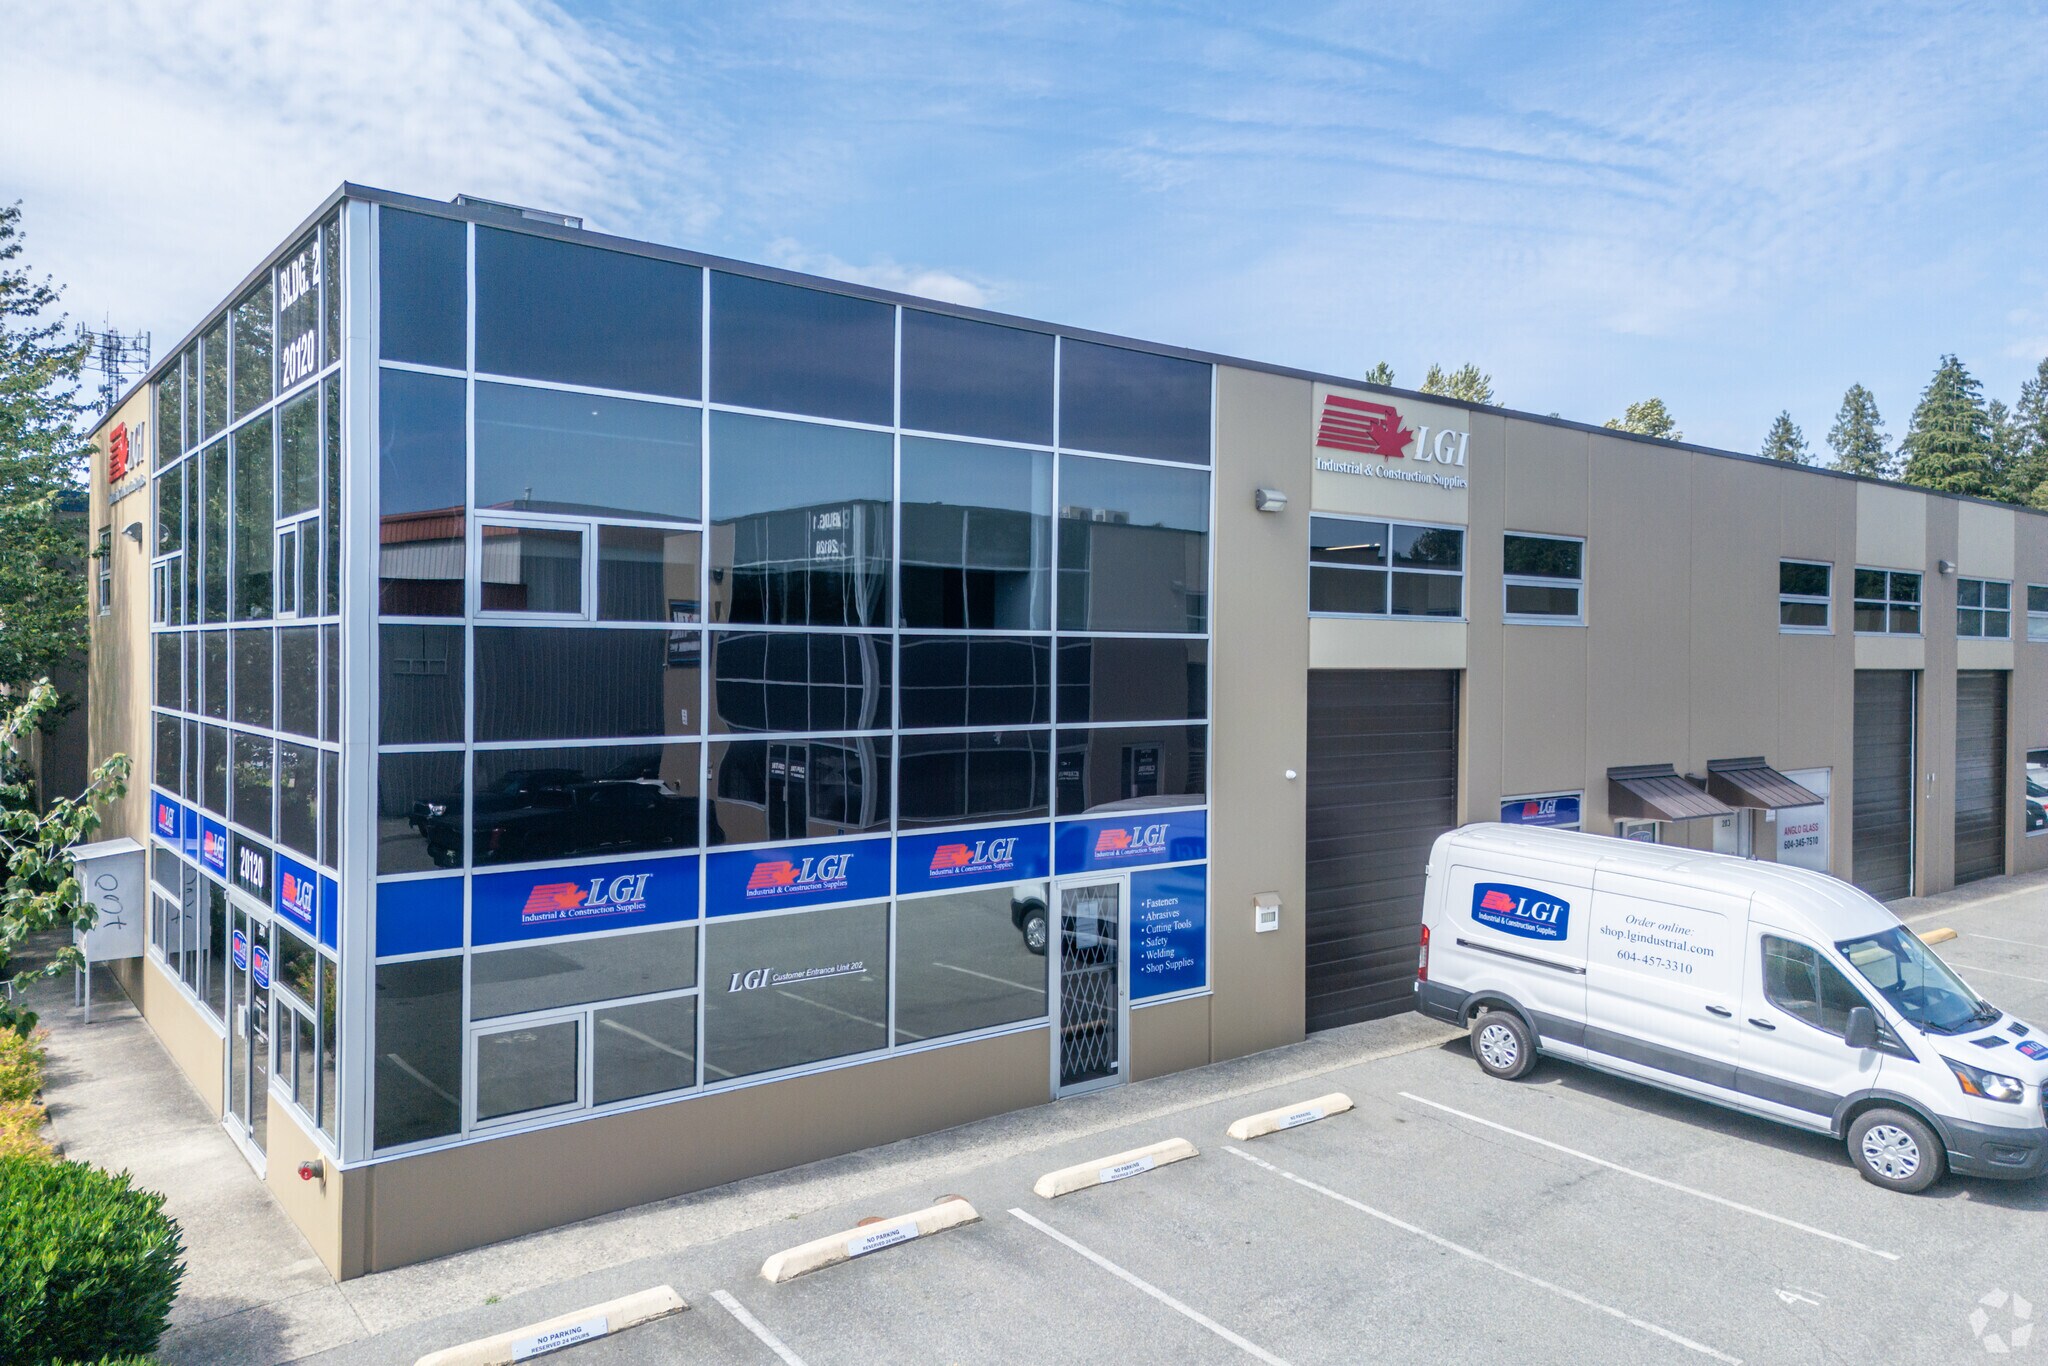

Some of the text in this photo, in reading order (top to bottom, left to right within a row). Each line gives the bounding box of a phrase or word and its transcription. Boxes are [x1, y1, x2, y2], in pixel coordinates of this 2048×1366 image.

[280, 242, 320, 312] BLDG. 2
[282, 330, 314, 388] 20120
[1414, 426, 1470, 468] LGI
[1316, 457, 1468, 490] Industrial & Construction Supplies
[1538, 800, 1558, 814] LGI
[1130, 824, 1168, 848] LGI
[1784, 823, 1818, 835] ANGLO GLASS
[972, 837, 1016, 864] LGI
[1121, 846, 1148, 855] Construction
[1784, 836, 1818, 850] 604-345-7510
[240, 846, 263, 888] 20120
[797, 854, 851, 883] LGI
[961, 864, 992, 872] Construction
[296, 878, 314, 911] LGI
[584, 873, 650, 906] LGI
[746, 887, 775, 896] Industrial
[784, 882, 822, 892] Construction
[823, 880, 848, 889] Supplies
[522, 912, 557, 922] Industrial
[568, 904, 614, 916] Construction
[616, 902, 646, 912] Supplies
[1146, 898, 1178, 908] Fasteners
[1514, 897, 1562, 923] LGI
[1146, 910, 1180, 921] Abrasives
[1478, 912, 1500, 923] Industrial
[1506, 918, 1536, 931] Construction
[1536, 925, 1557, 936] Supplies
[1626, 914, 1695, 936] Order online:
[1146, 919, 1192, 934] Cutting Tools
[1146, 936, 1168, 947] Safety
[1600, 926, 1714, 957] shop.lgindustrial.com
[1146, 948, 1175, 959] Welding
[1617, 950, 1693, 974] 604-457-3310
[1146, 957, 1194, 973] Shop Supplies
[728, 962, 863, 992] LGI Customer Entrance Unit 202
[1121, 1162, 1140, 1171] PARKING
[876, 1229, 900, 1240] PARKING
[863, 1241, 885, 1250] RESERVED
[531, 1341, 560, 1353] RESERVED
[570, 1333, 590, 1342] HOURS
[550, 1326, 582, 1340] PARKING
